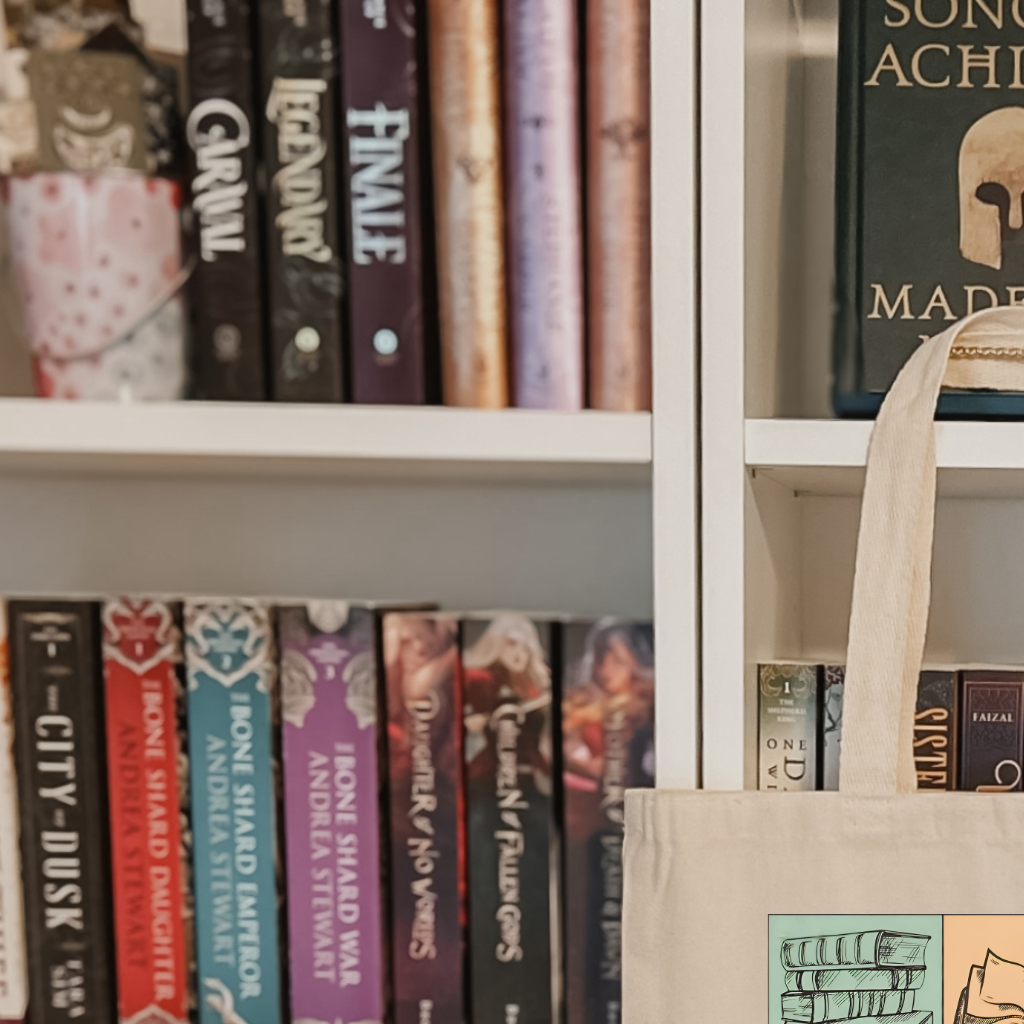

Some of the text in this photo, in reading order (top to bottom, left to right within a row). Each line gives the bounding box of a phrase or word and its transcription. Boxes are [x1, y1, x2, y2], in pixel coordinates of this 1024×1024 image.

[347, 101, 410, 265] FINALE
[767, 738, 807, 750] ONE
[784, 682, 791, 693] 1
[972, 712, 1014, 723] FAIZAL
[35, 715, 78, 806] CITY
[41, 831, 84, 930] DUSK
[142, 691, 175, 1002] BONE SHARD DAUGHTER
[205, 733, 235, 968] ANDREA STEWART
[229, 705, 262, 1000] BONE SHARD EMPEROR
[308, 750, 336, 984] ANDREA STEWART
[334, 755, 362, 988] BONE SHARD WAR
[407, 837, 440, 874] NO
